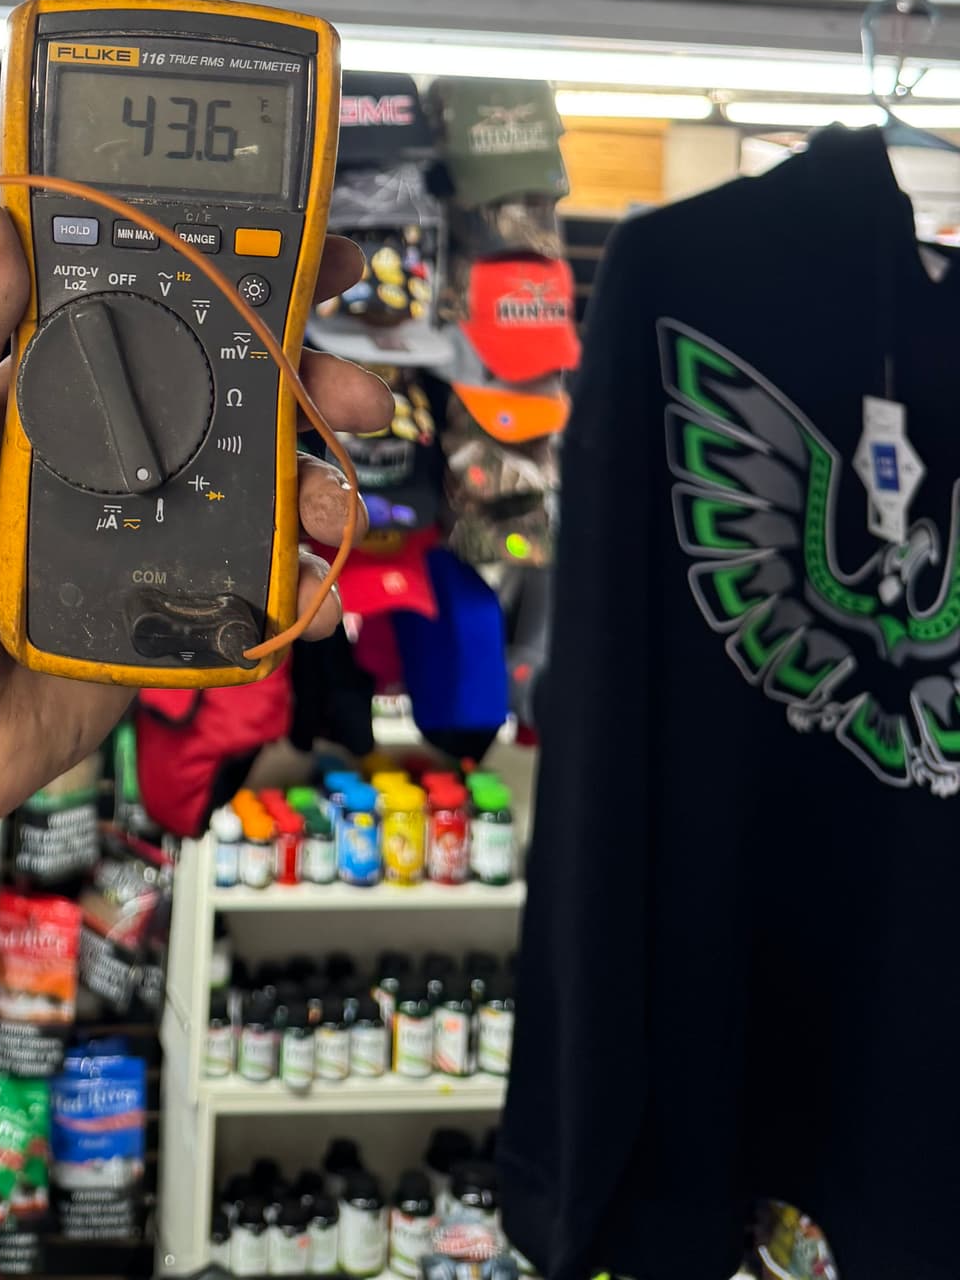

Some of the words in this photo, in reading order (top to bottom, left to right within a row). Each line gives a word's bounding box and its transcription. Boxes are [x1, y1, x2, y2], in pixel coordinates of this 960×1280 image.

[57, 47, 131, 61] FLUKE
[141, 52, 165, 65] 116
[169, 54, 197, 66] TRUE
[200, 56, 225, 67] RMS
[229, 59, 301, 73] MULTIMETER
[122, 95, 238, 162] 43.6
[60, 225, 90, 236] HOLD
[117, 229, 133, 239] MIN
[135, 230, 155, 241] MAX
[179, 233, 215, 245] RANGE
[53, 265, 99, 278] AUTO-V
[176, 271, 191, 282] Hz
[64, 279, 87, 290] LoZ
[108, 273, 137, 286] OFF
[160, 282, 171, 297] V
[195, 309, 207, 325] V
[220, 345, 248, 360] mV
[132, 570, 167, 584] COM
